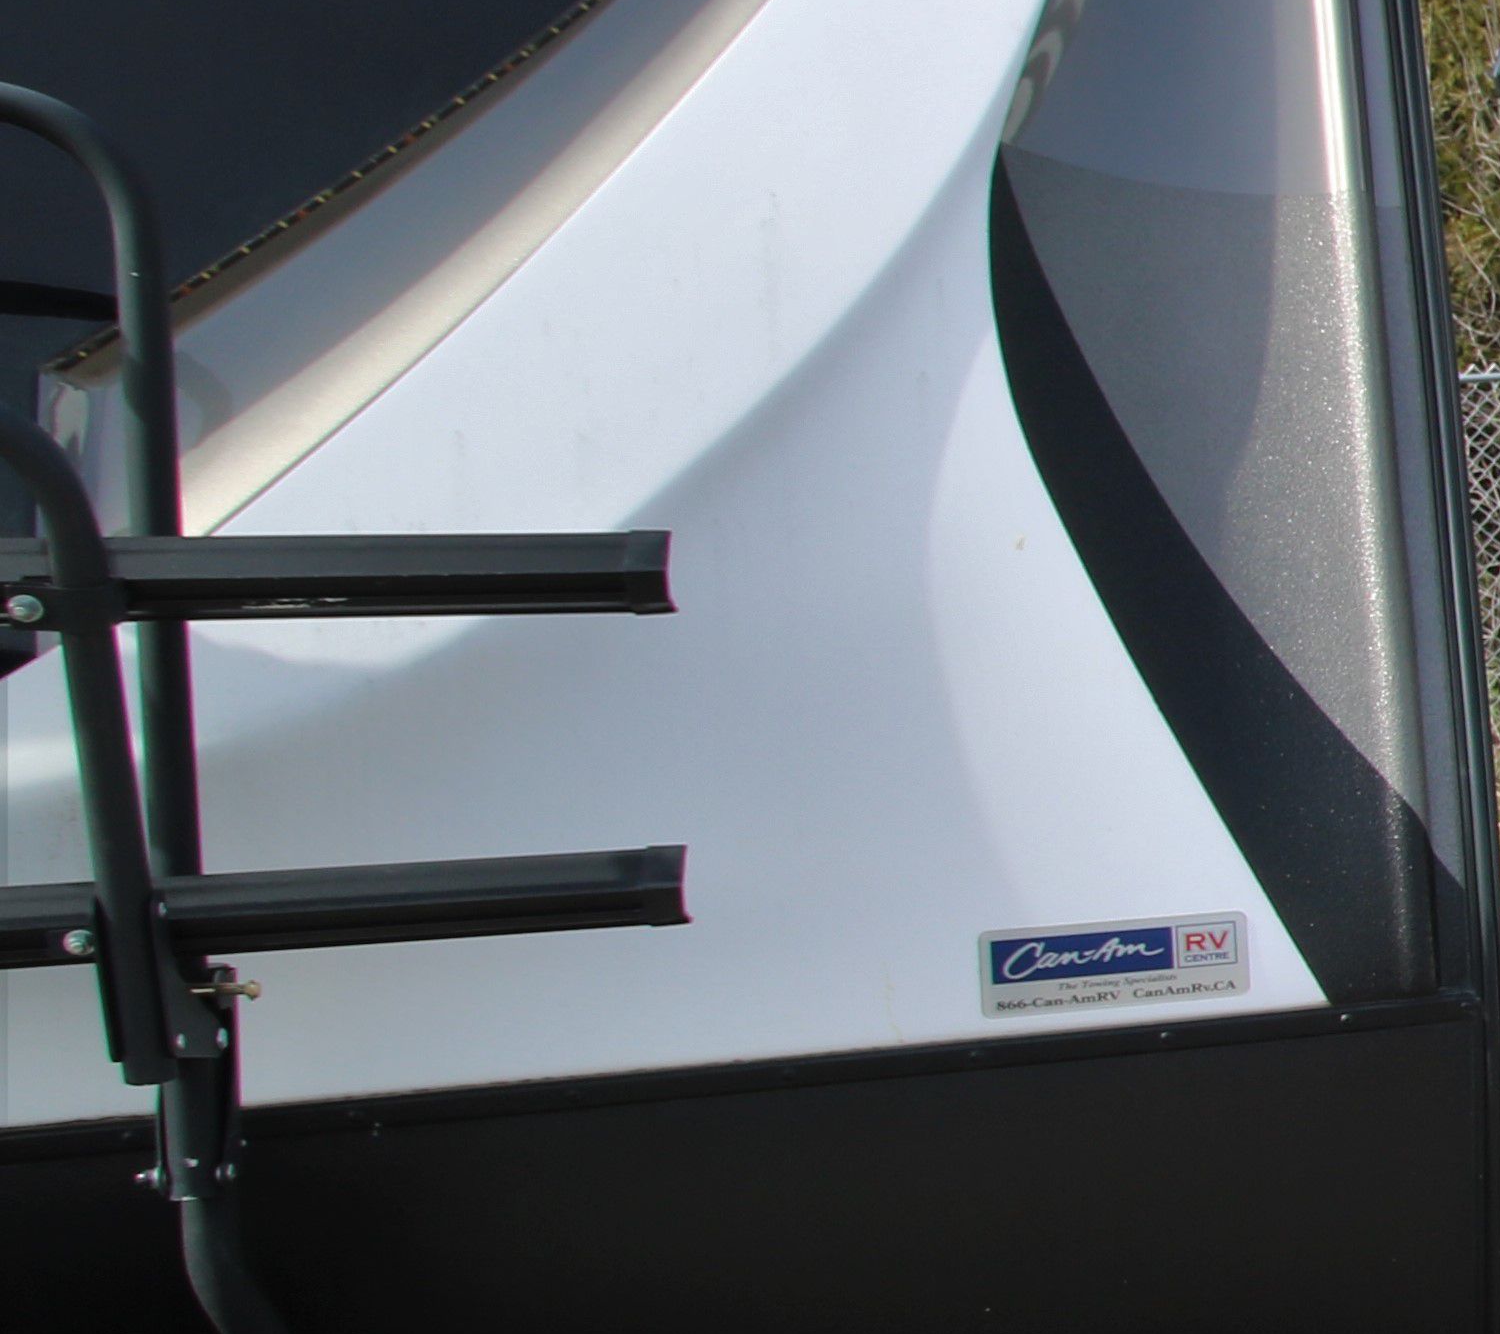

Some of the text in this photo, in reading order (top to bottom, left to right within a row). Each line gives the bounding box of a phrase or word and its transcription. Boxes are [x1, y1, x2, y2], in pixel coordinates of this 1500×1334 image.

[1002, 929, 1230, 981] Can-Am RV
[1184, 950, 1231, 964] CENTRE
